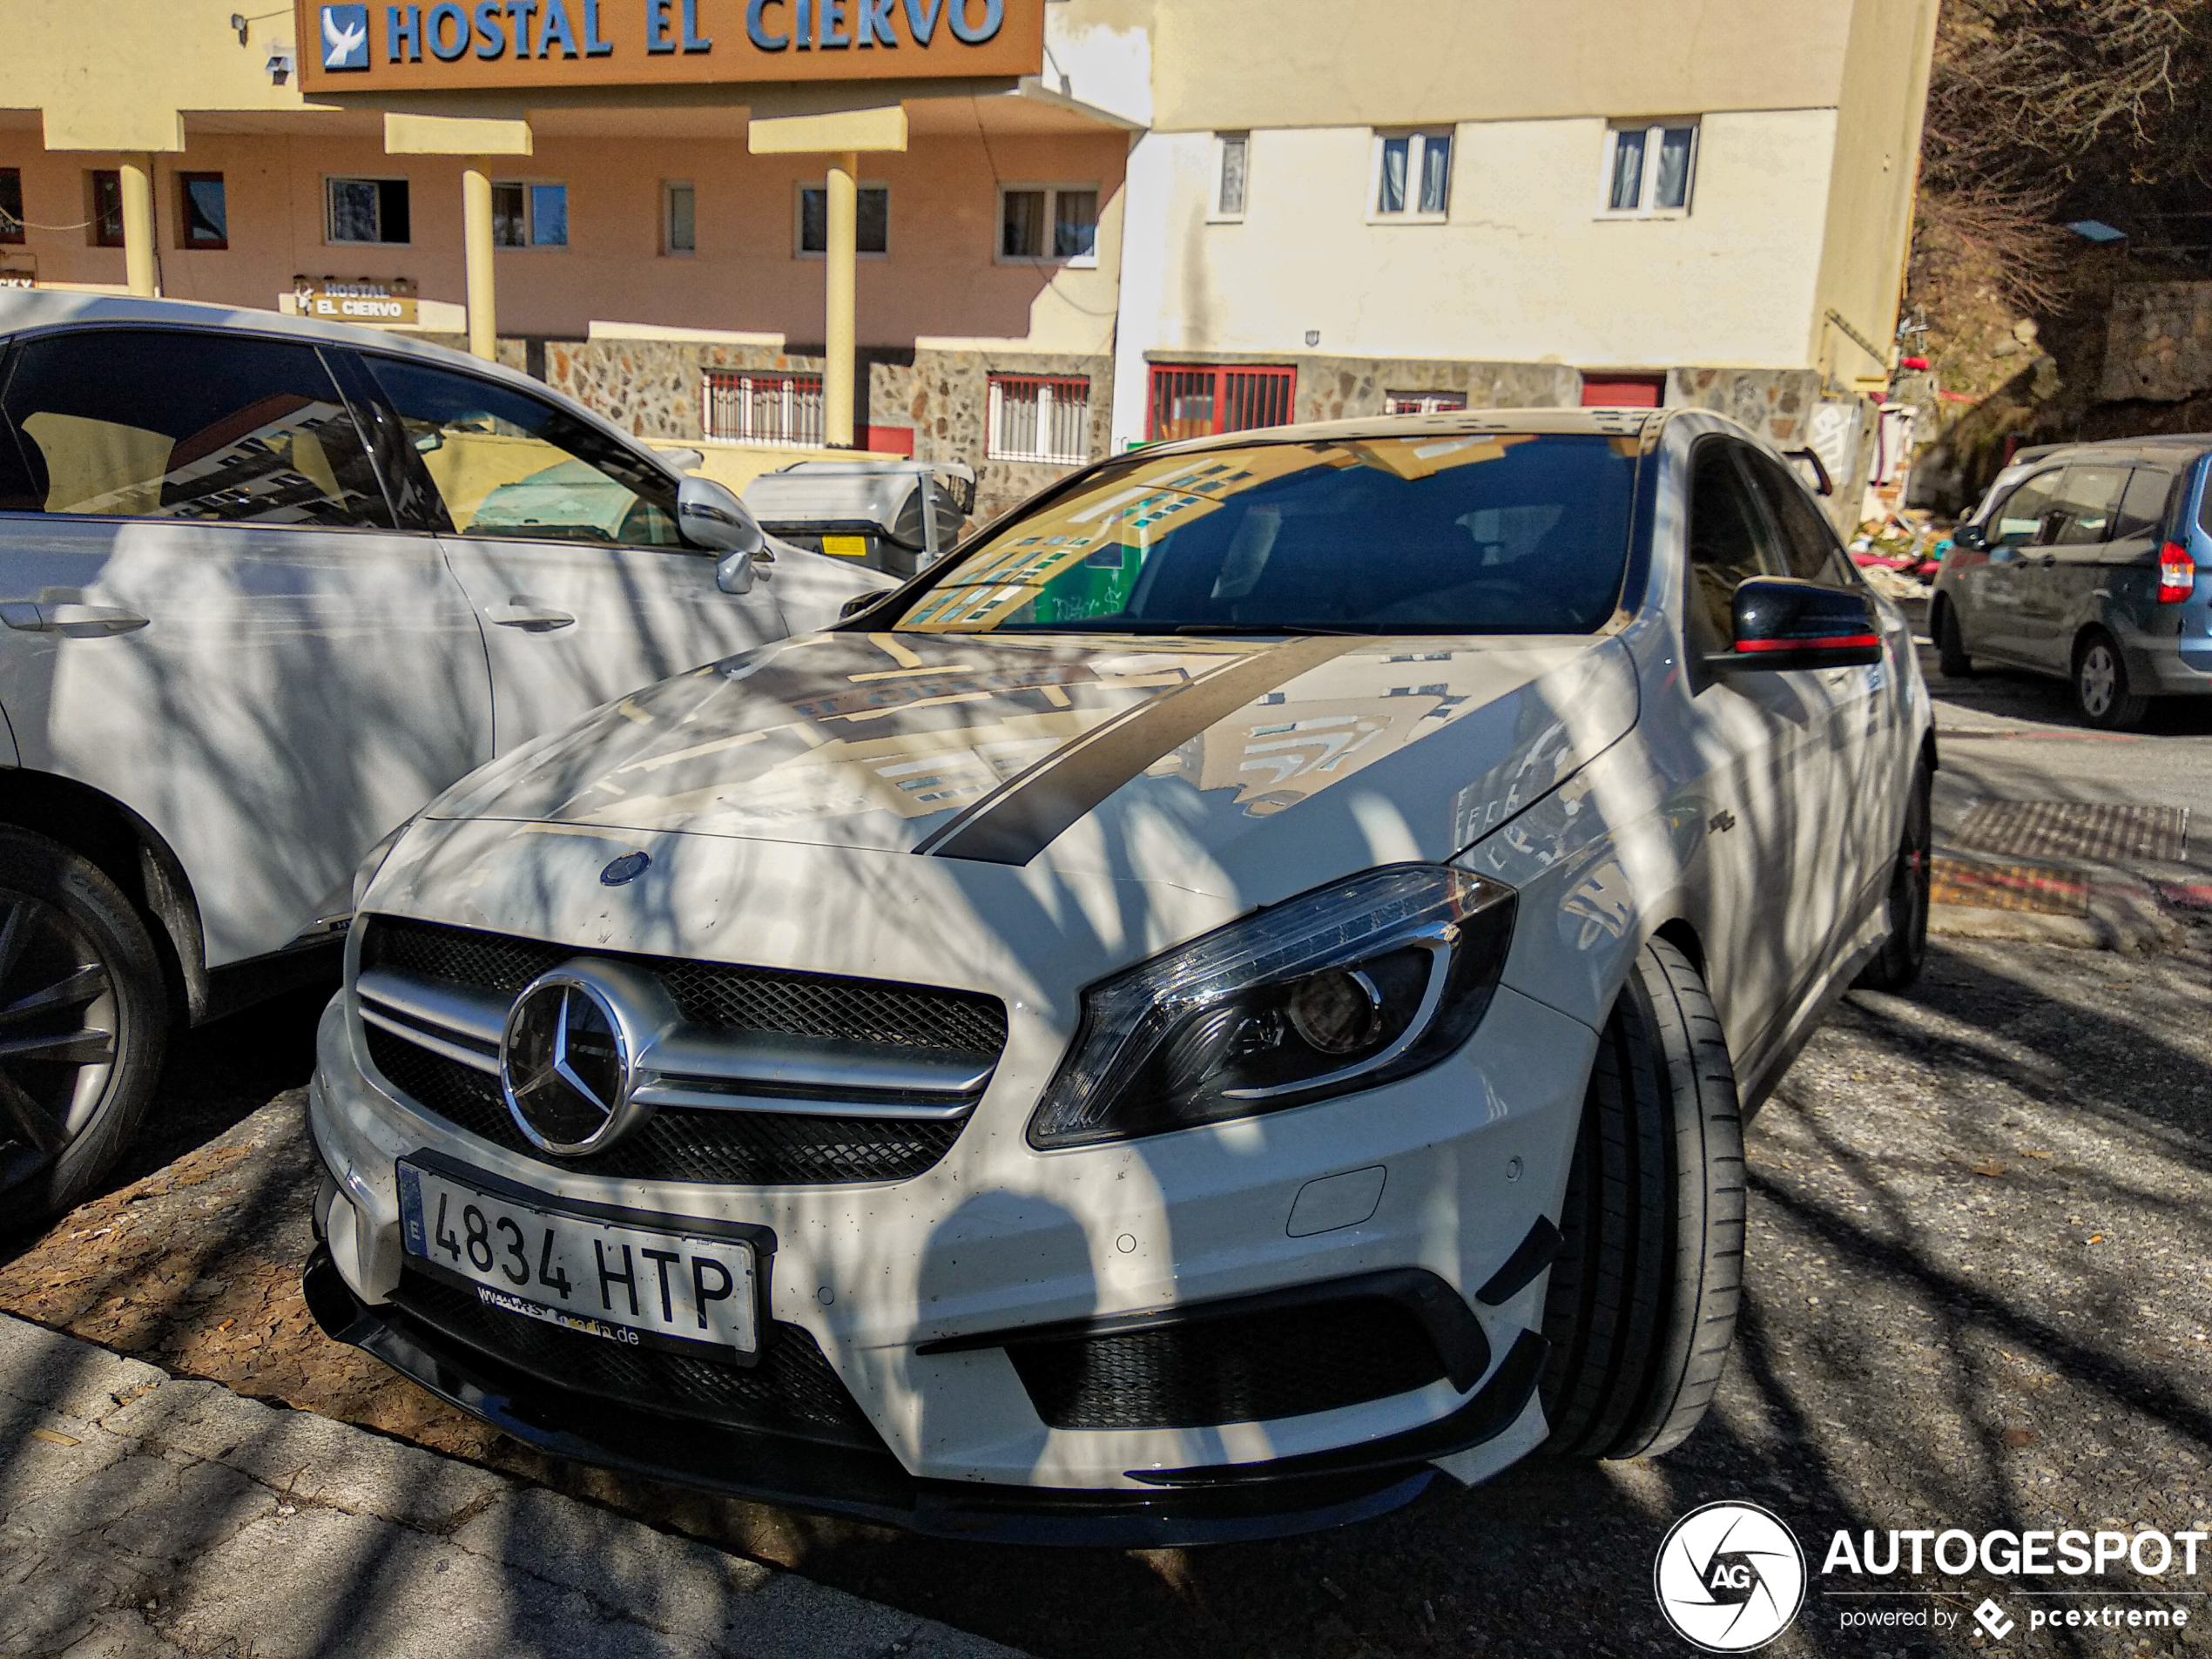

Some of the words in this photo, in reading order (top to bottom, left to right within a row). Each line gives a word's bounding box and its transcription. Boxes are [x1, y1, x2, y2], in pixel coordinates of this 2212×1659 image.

[387, 0, 613, 63] HOSTAL
[646, 0, 712, 55] EL
[745, 0, 1004, 52] CIERVO
[324, 283, 391, 299] HOSTAL
[316, 300, 338, 314] EL
[341, 300, 401, 317] CIERVO
[409, 1219, 421, 1241] E
[436, 1192, 572, 1299] 4834
[594, 1238, 733, 1330] HTP
